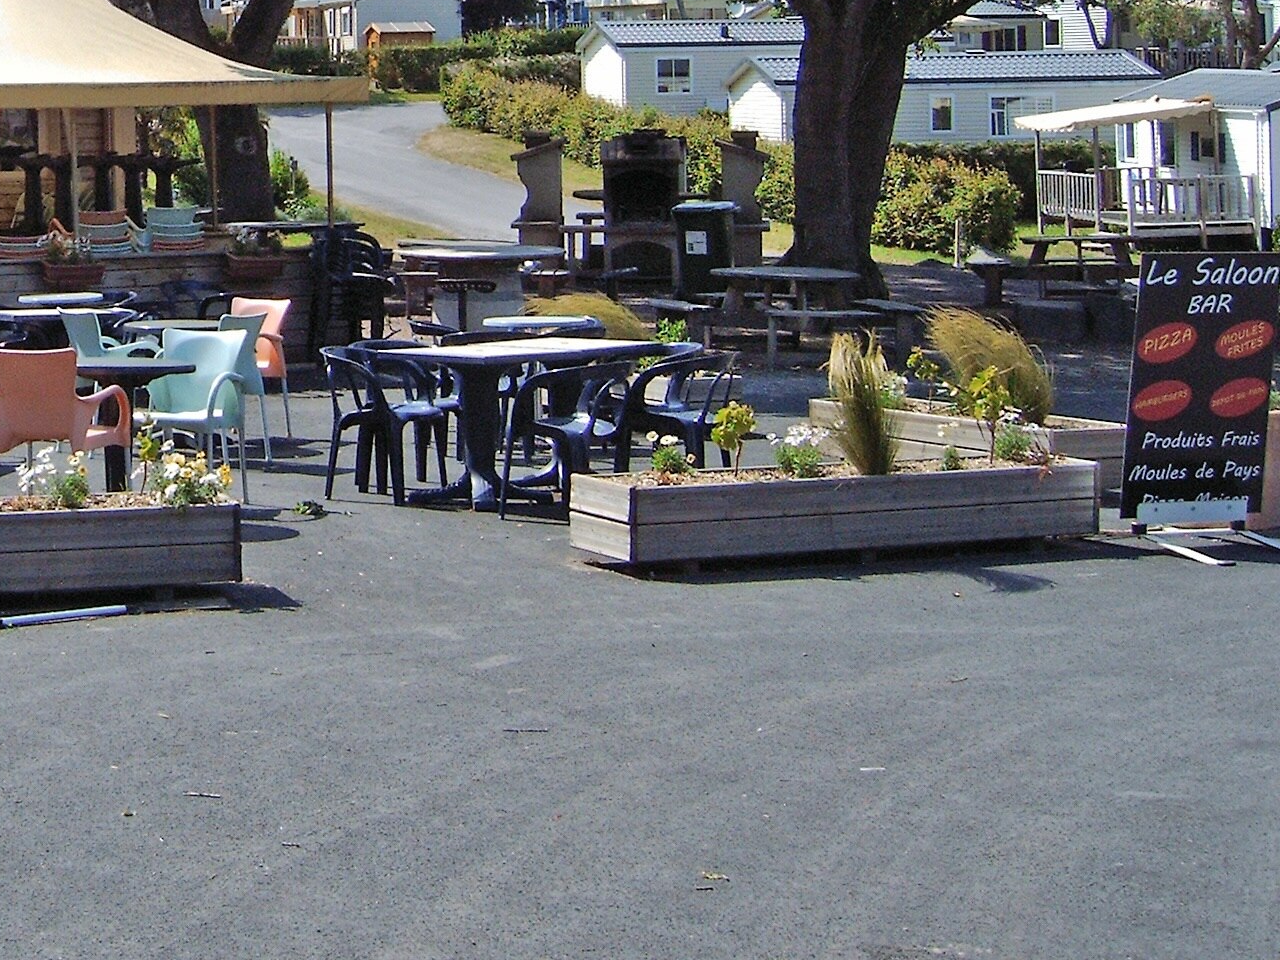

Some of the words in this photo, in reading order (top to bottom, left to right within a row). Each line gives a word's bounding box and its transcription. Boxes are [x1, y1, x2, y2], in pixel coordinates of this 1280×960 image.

[1146, 259, 1178, 286] Le
[1192, 257, 1280, 286] Saloon
[1187, 293, 1232, 315] BAR
[1144, 327, 1193, 355] PIZZA
[1220, 321, 1265, 346] MOULES
[1227, 336, 1263, 358] FRITES
[1141, 430, 1214, 450] Produits
[1221, 430, 1260, 448] Frais
[1128, 464, 1188, 482] Moules
[1194, 461, 1214, 479] de
[1222, 460, 1261, 481] Pays
